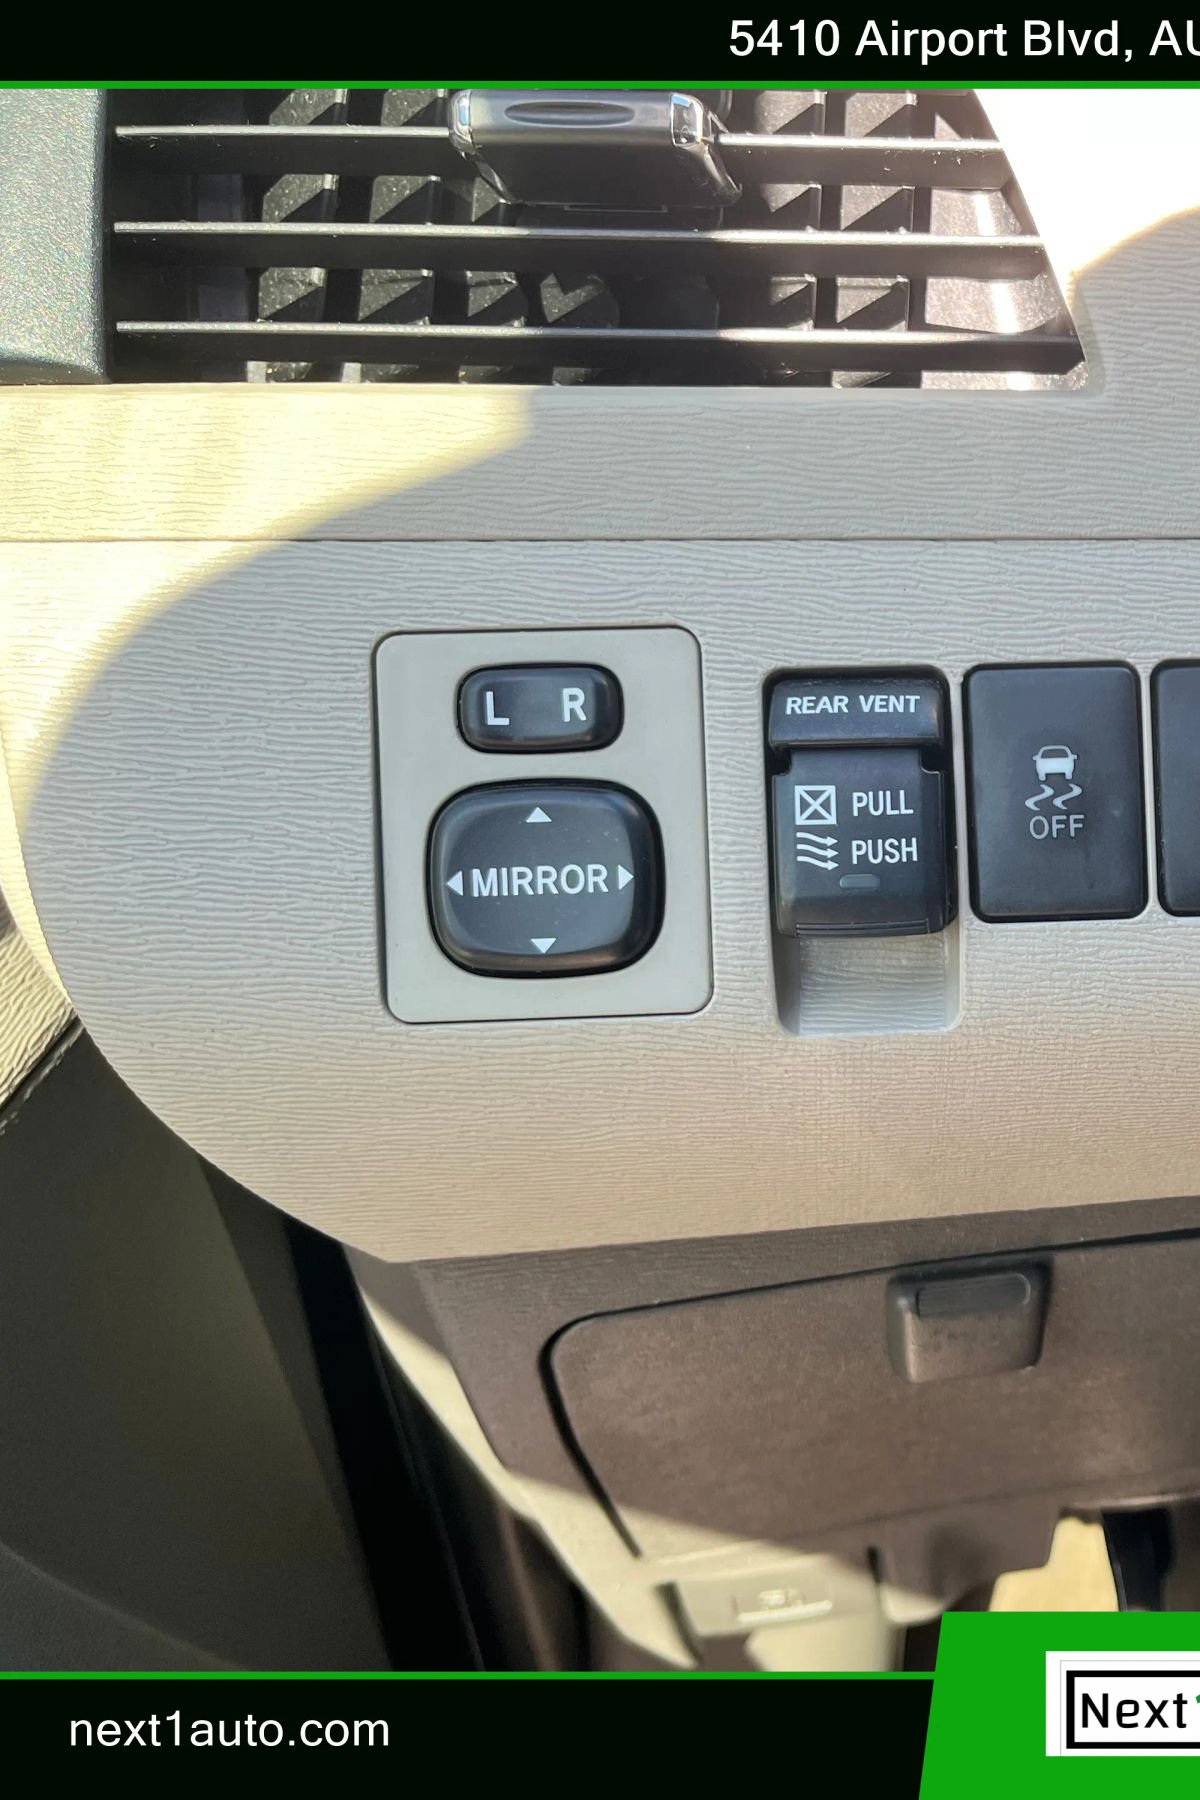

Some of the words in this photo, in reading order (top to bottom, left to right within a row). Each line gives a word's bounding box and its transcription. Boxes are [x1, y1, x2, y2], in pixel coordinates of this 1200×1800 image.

[485, 691, 510, 726] L
[562, 688, 587, 722] R
[785, 696, 849, 715] REAR
[858, 694, 921, 714] VENT
[852, 790, 914, 817] PULL
[1029, 814, 1085, 840] OFF
[851, 838, 918, 865] PUSH
[471, 864, 609, 898] MIRROR
